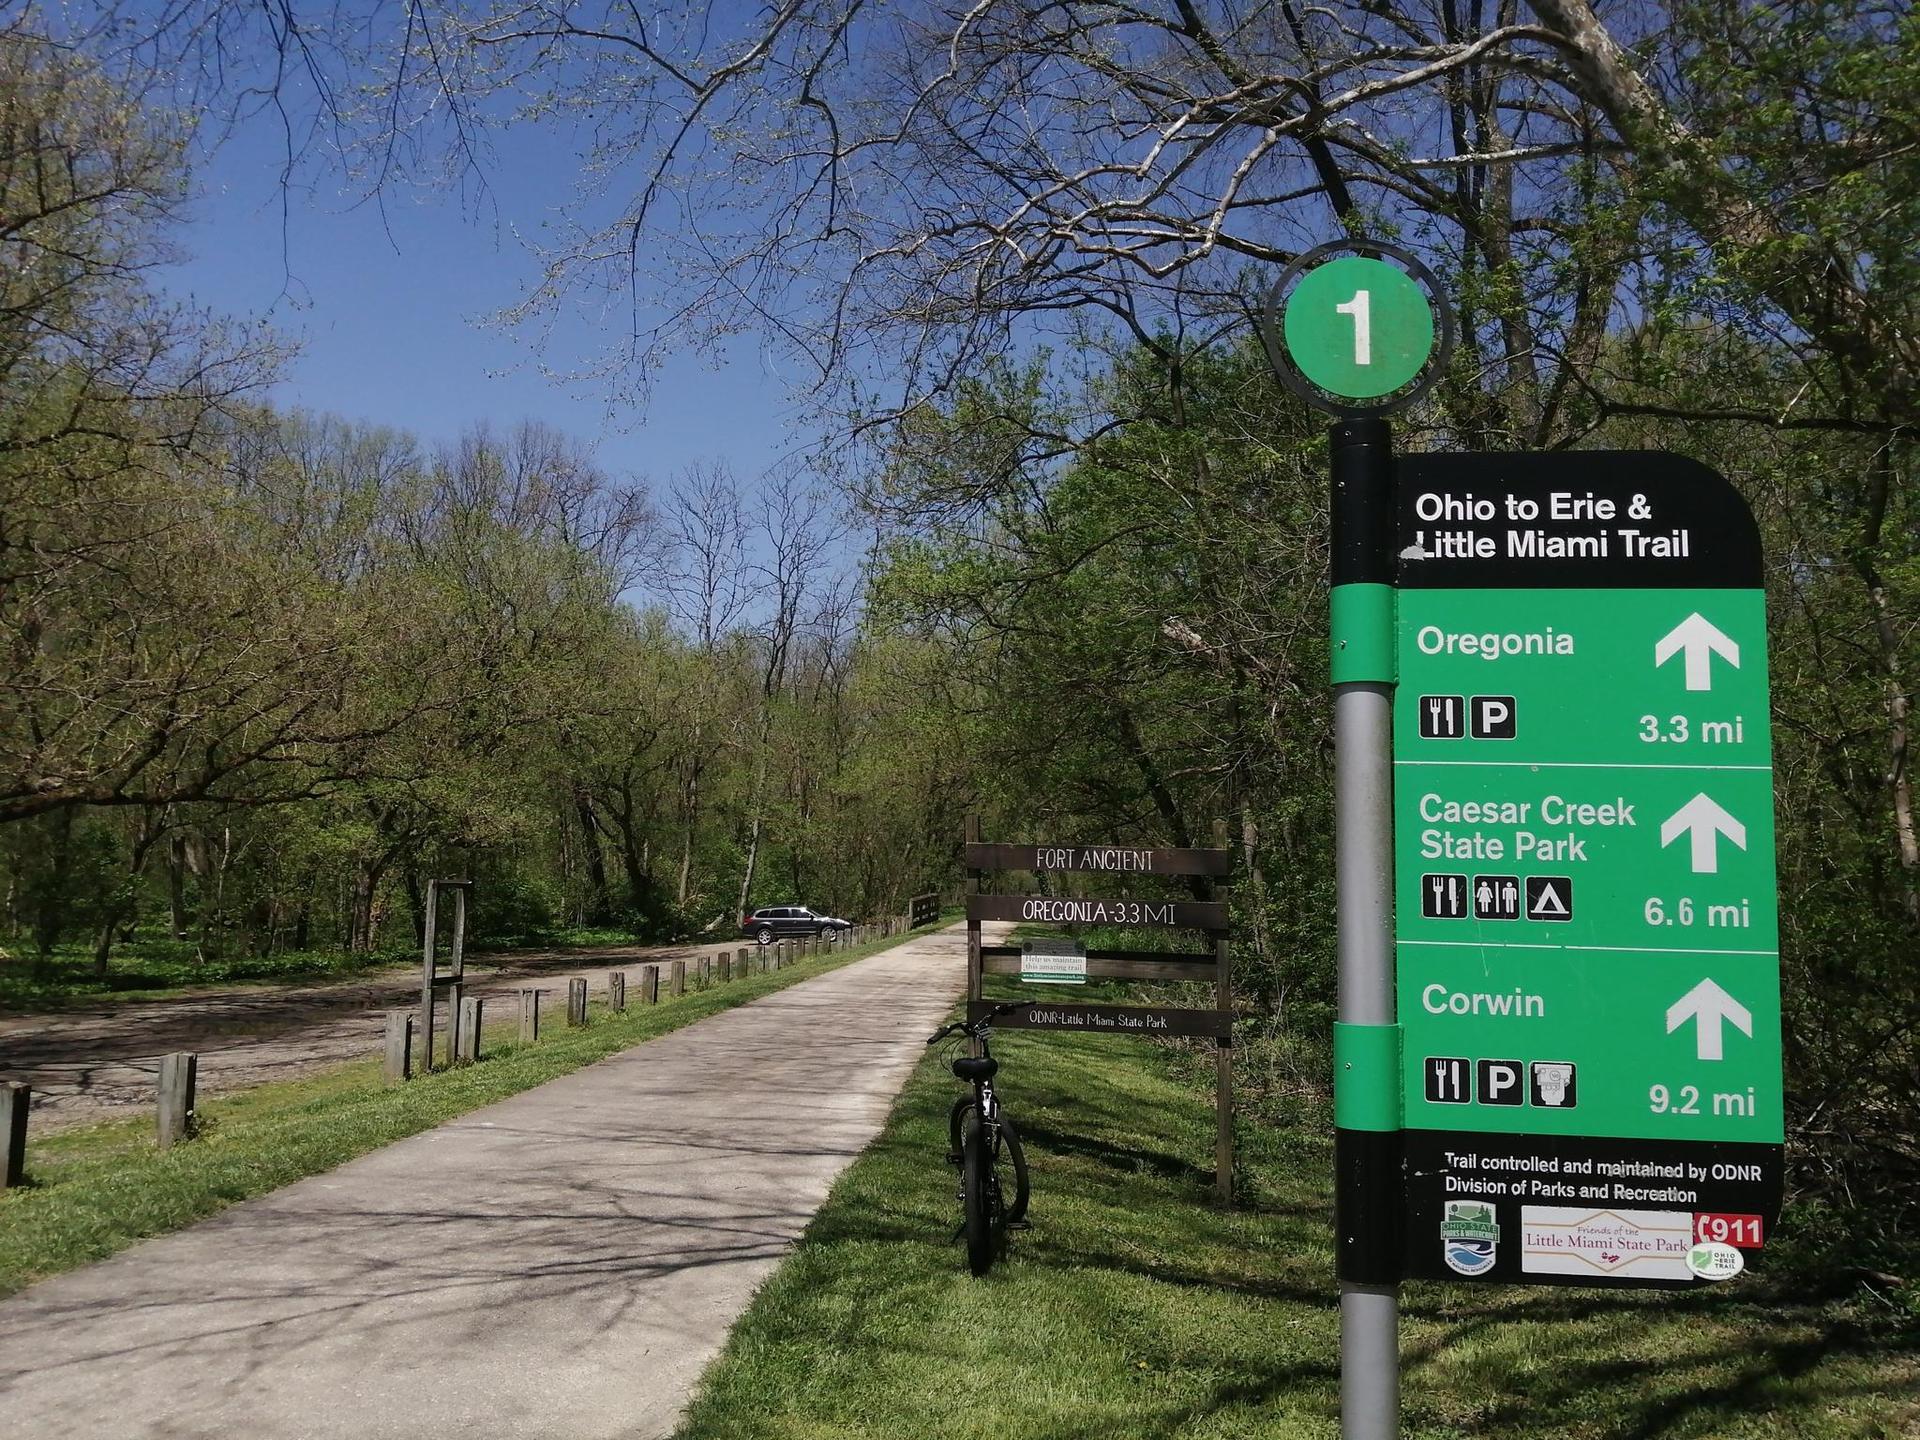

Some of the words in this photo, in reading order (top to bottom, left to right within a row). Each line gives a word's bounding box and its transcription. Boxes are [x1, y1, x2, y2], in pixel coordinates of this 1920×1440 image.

[1336, 290, 1371, 365] 1
[1416, 493, 1495, 522] Ohio
[1505, 495, 1540, 520] to
[1550, 492, 1616, 520] Erie
[1628, 494, 1653, 520] &
[1416, 531, 1496, 559] Little
[1507, 530, 1608, 559] Miami
[1618, 530, 1689, 558] Trail
[1417, 626, 1574, 660] Oregonia
[1639, 715, 1690, 743] 3.3
[1702, 715, 1743, 743] mi
[1419, 794, 1531, 824] Caesar
[1541, 796, 1636, 826] Creek
[1036, 848, 1075, 869] FORT
[1080, 849, 1153, 871] ANCIENT
[1420, 830, 1504, 860] State
[1516, 832, 1587, 861] Park
[1644, 898, 1694, 926] 6.6
[1708, 899, 1750, 927] mi
[1026, 955, 1042, 963] Help
[1422, 984, 1544, 1017] Corwin
[1087, 1013, 1114, 1026] Miami
[1118, 1014, 1143, 1027] State
[1146, 1014, 1167, 1028] Park
[1649, 1084, 1700, 1115] 9.2
[1714, 1087, 1755, 1116] mi
[1445, 1152, 1476, 1169] Trail
[1481, 1156, 1559, 1173] controlled
[1563, 1158, 1592, 1174] and
[1597, 1160, 1684, 1178] maintained
[1689, 1163, 1707, 1182] by
[1712, 1164, 1762, 1181] ODNR
[1446, 1176, 1506, 1194] Division
[1511, 1180, 1527, 1195] of
[1532, 1180, 1575, 1197] Parks
[1579, 1184, 1608, 1199] and
[1614, 1184, 1697, 1202] Recreation
[1443, 1222, 1466, 1230] OHIO
[1578, 1226, 1611, 1235] Friends
[1614, 1226, 1622, 1236] of
[1625, 1228, 1639, 1236] the
[1712, 1218, 1759, 1243] 911
[1526, 1234, 1563, 1246] Little
[1568, 1236, 1612, 1249] Miami
[1618, 1237, 1651, 1250] State
[1656, 1238, 1688, 1252] Park
